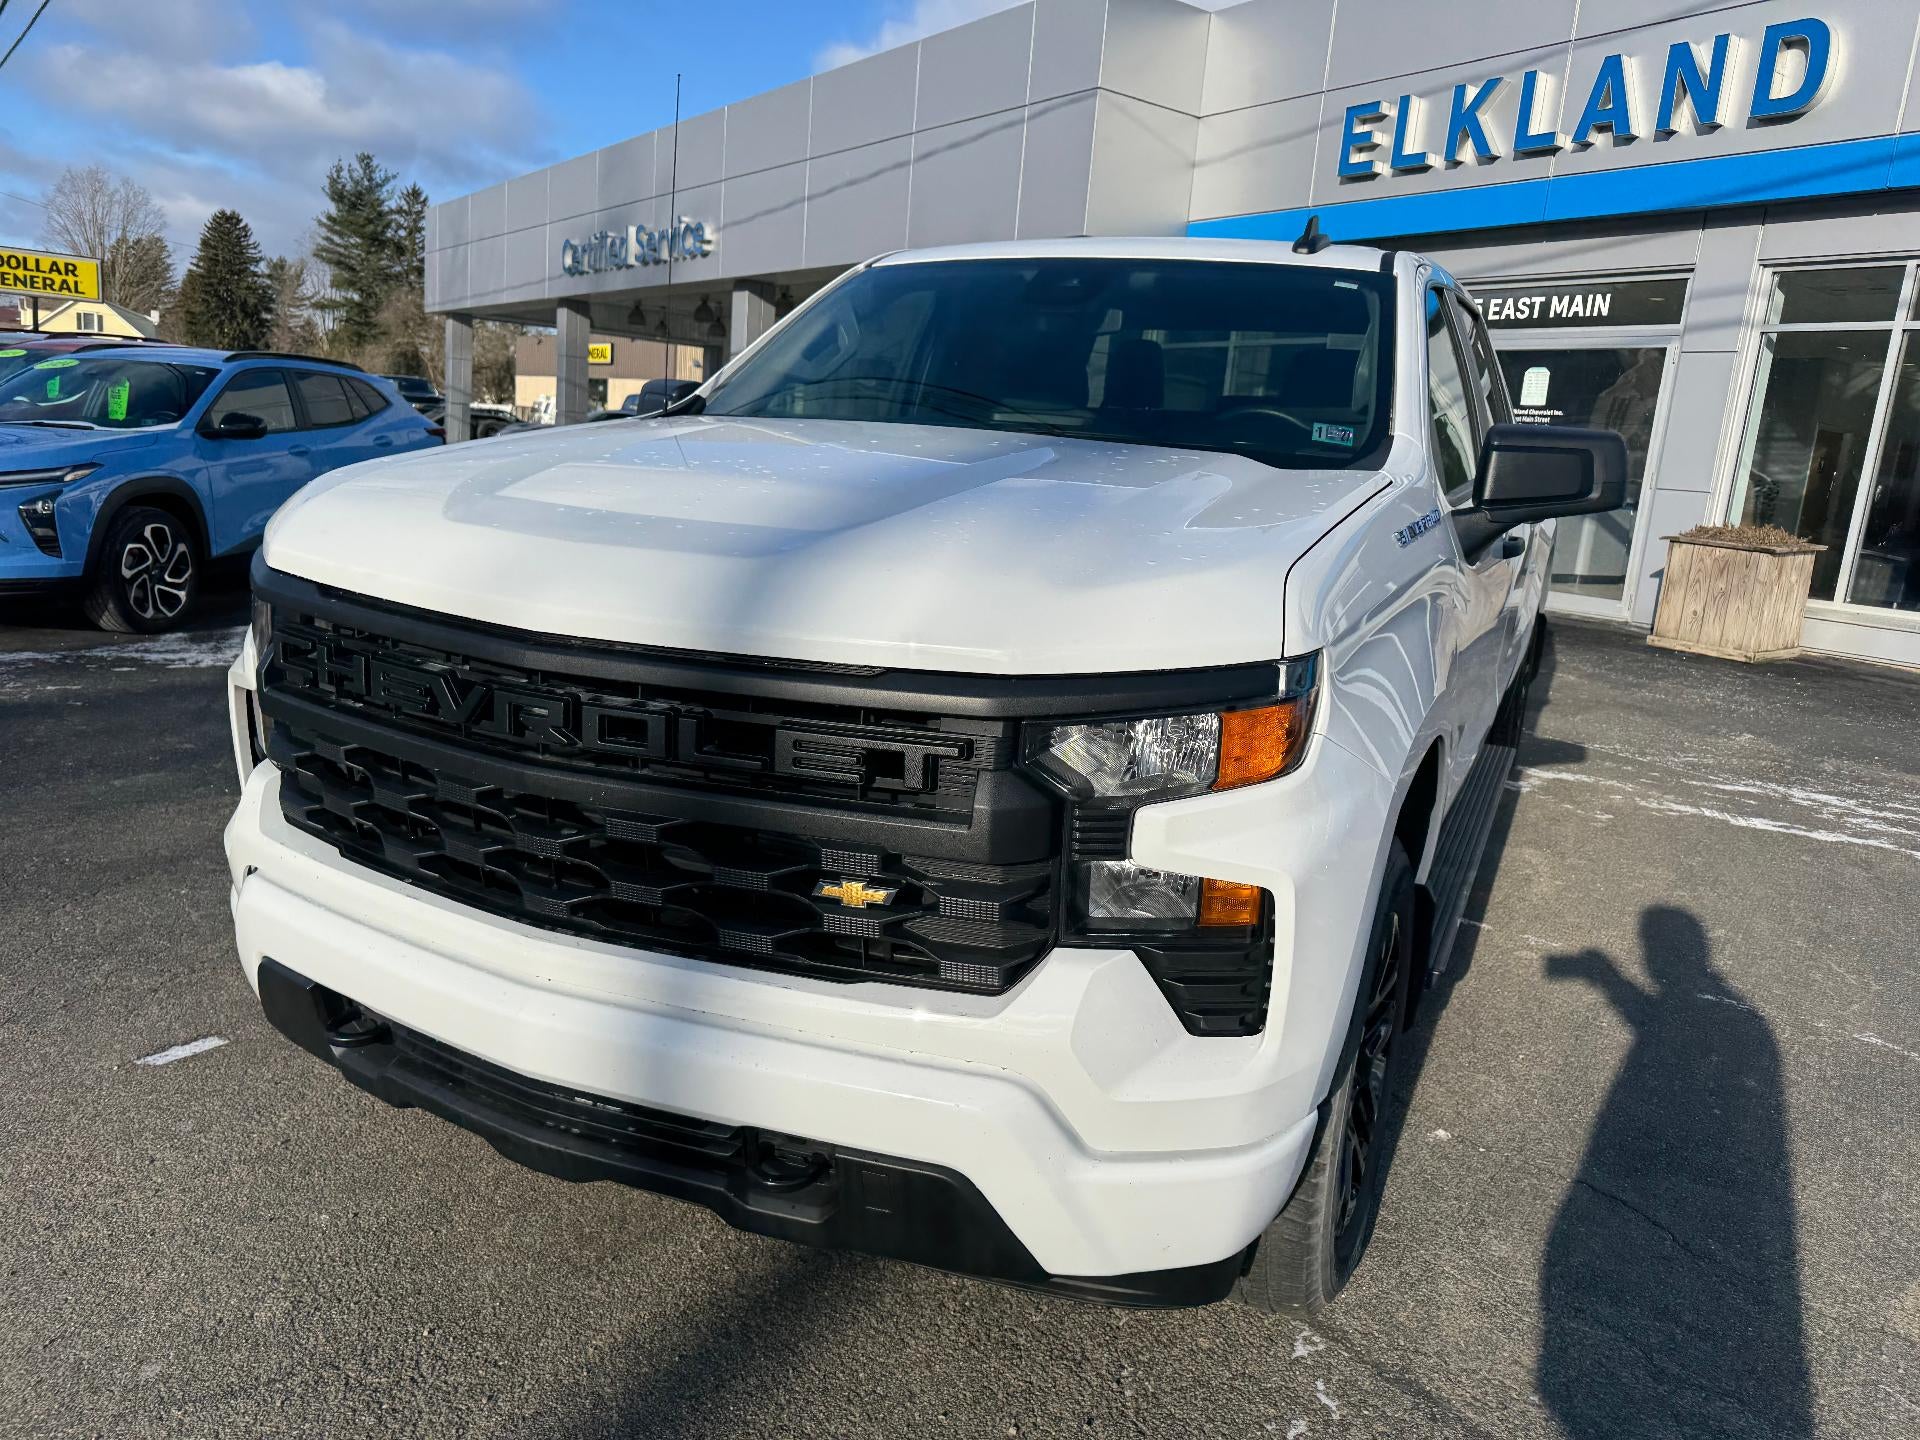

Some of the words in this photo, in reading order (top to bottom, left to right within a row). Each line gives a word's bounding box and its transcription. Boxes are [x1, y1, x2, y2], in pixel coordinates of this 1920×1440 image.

[1338, 17, 1836, 180] ELKLAND
[562, 224, 630, 275] Certified
[635, 215, 708, 265] Service
[1488, 297, 1546, 320] EAST
[1549, 294, 1611, 318] MAIN
[279, 631, 974, 792] CHEVROLET
